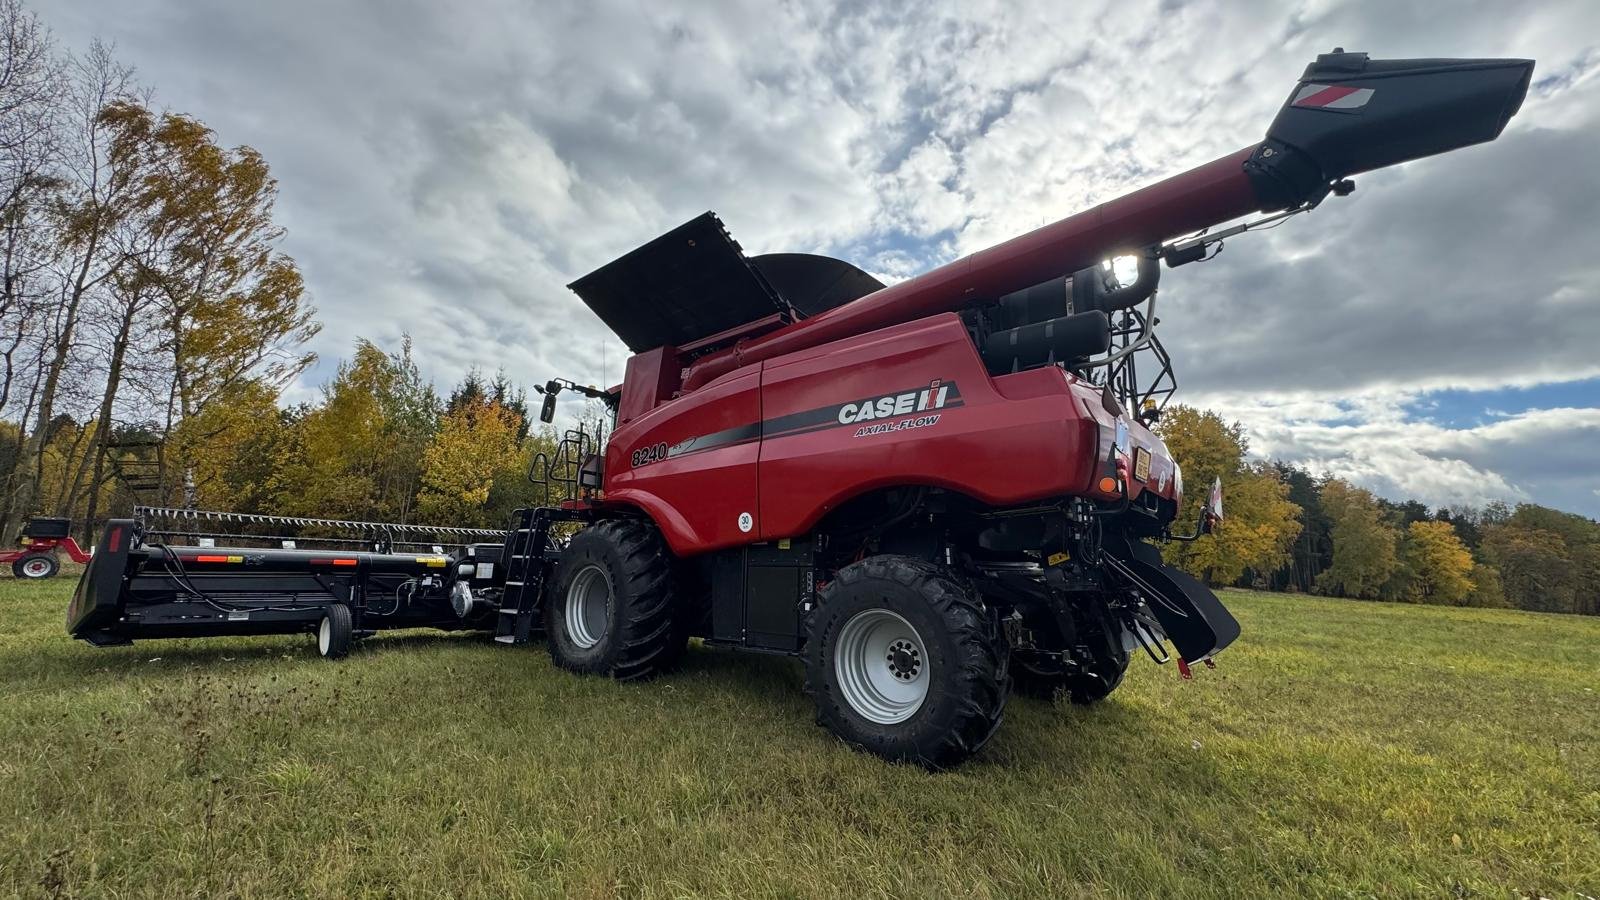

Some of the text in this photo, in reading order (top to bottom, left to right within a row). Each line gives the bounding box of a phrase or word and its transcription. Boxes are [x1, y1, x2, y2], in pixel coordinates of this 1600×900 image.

[838, 392, 916, 424] CASE
[854, 415, 941, 437] AXIAL-FLOW
[632, 442, 668, 468] 8240
[741, 515, 750, 525] 30
